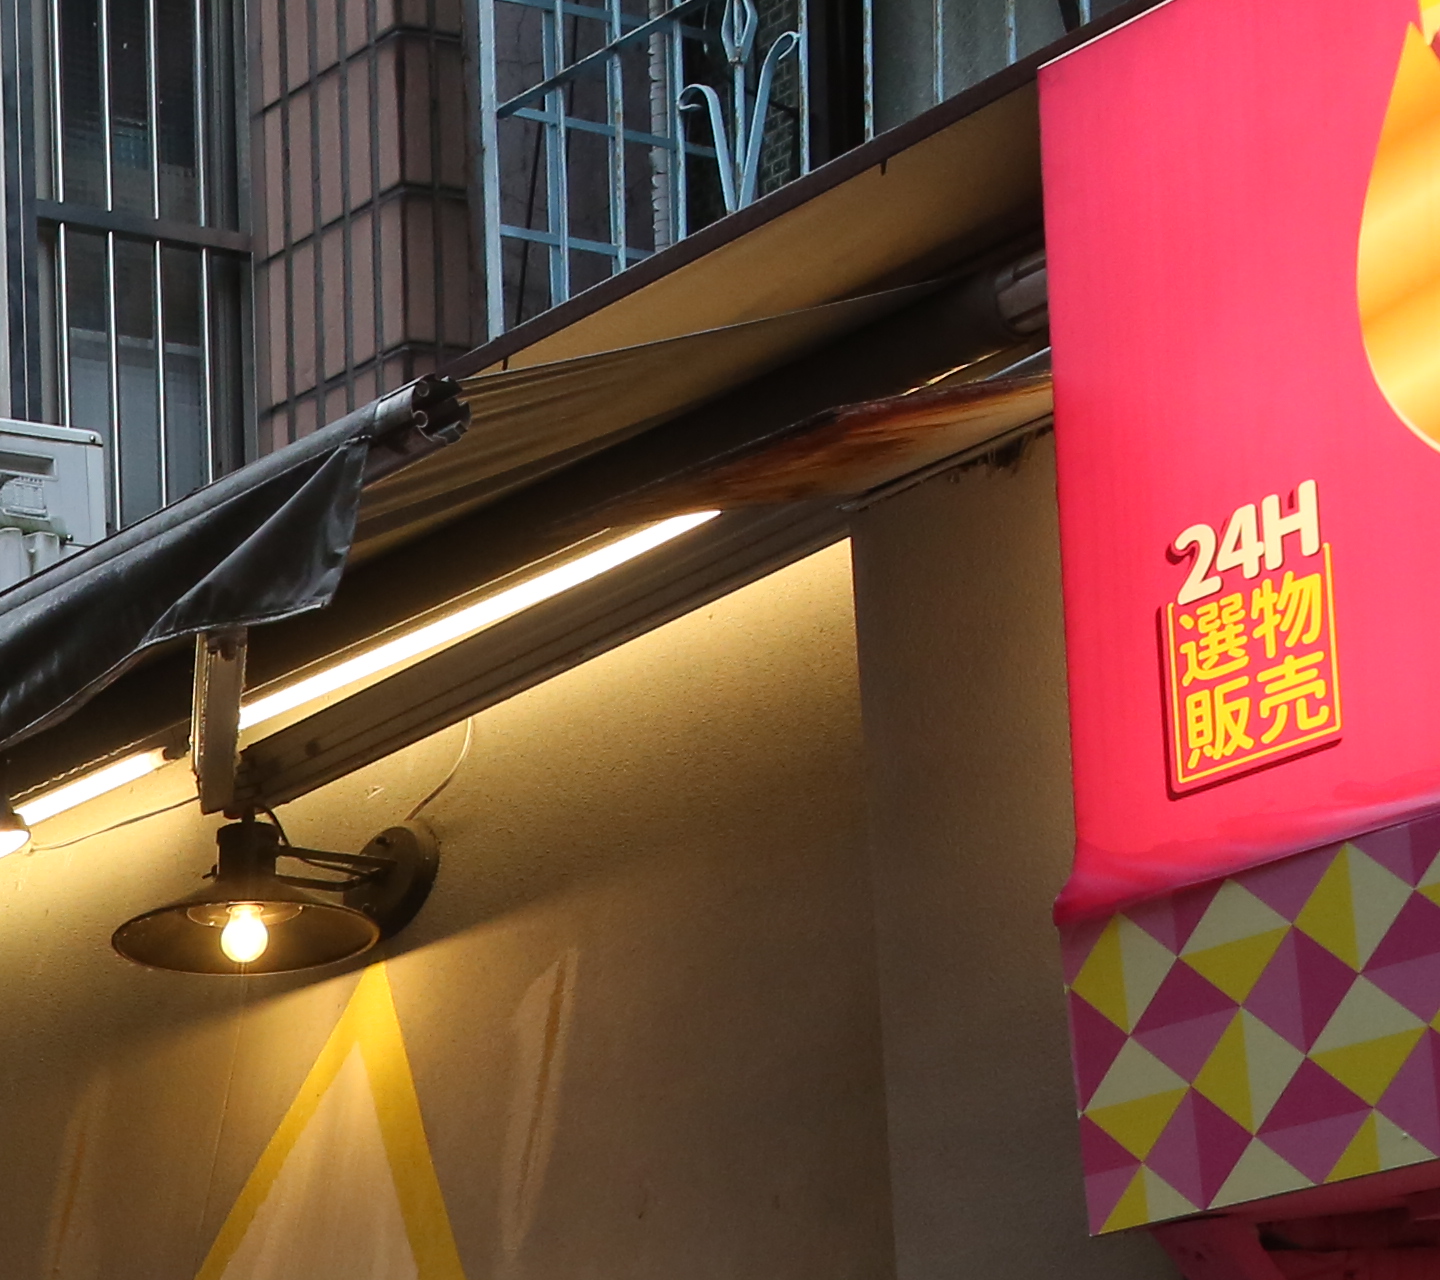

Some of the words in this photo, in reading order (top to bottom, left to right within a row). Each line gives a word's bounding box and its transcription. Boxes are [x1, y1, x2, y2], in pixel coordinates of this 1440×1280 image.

[1174, 479, 1321, 606] 24H
[1179, 570, 1323, 687] 選物
[1185, 651, 1330, 770] 販売
